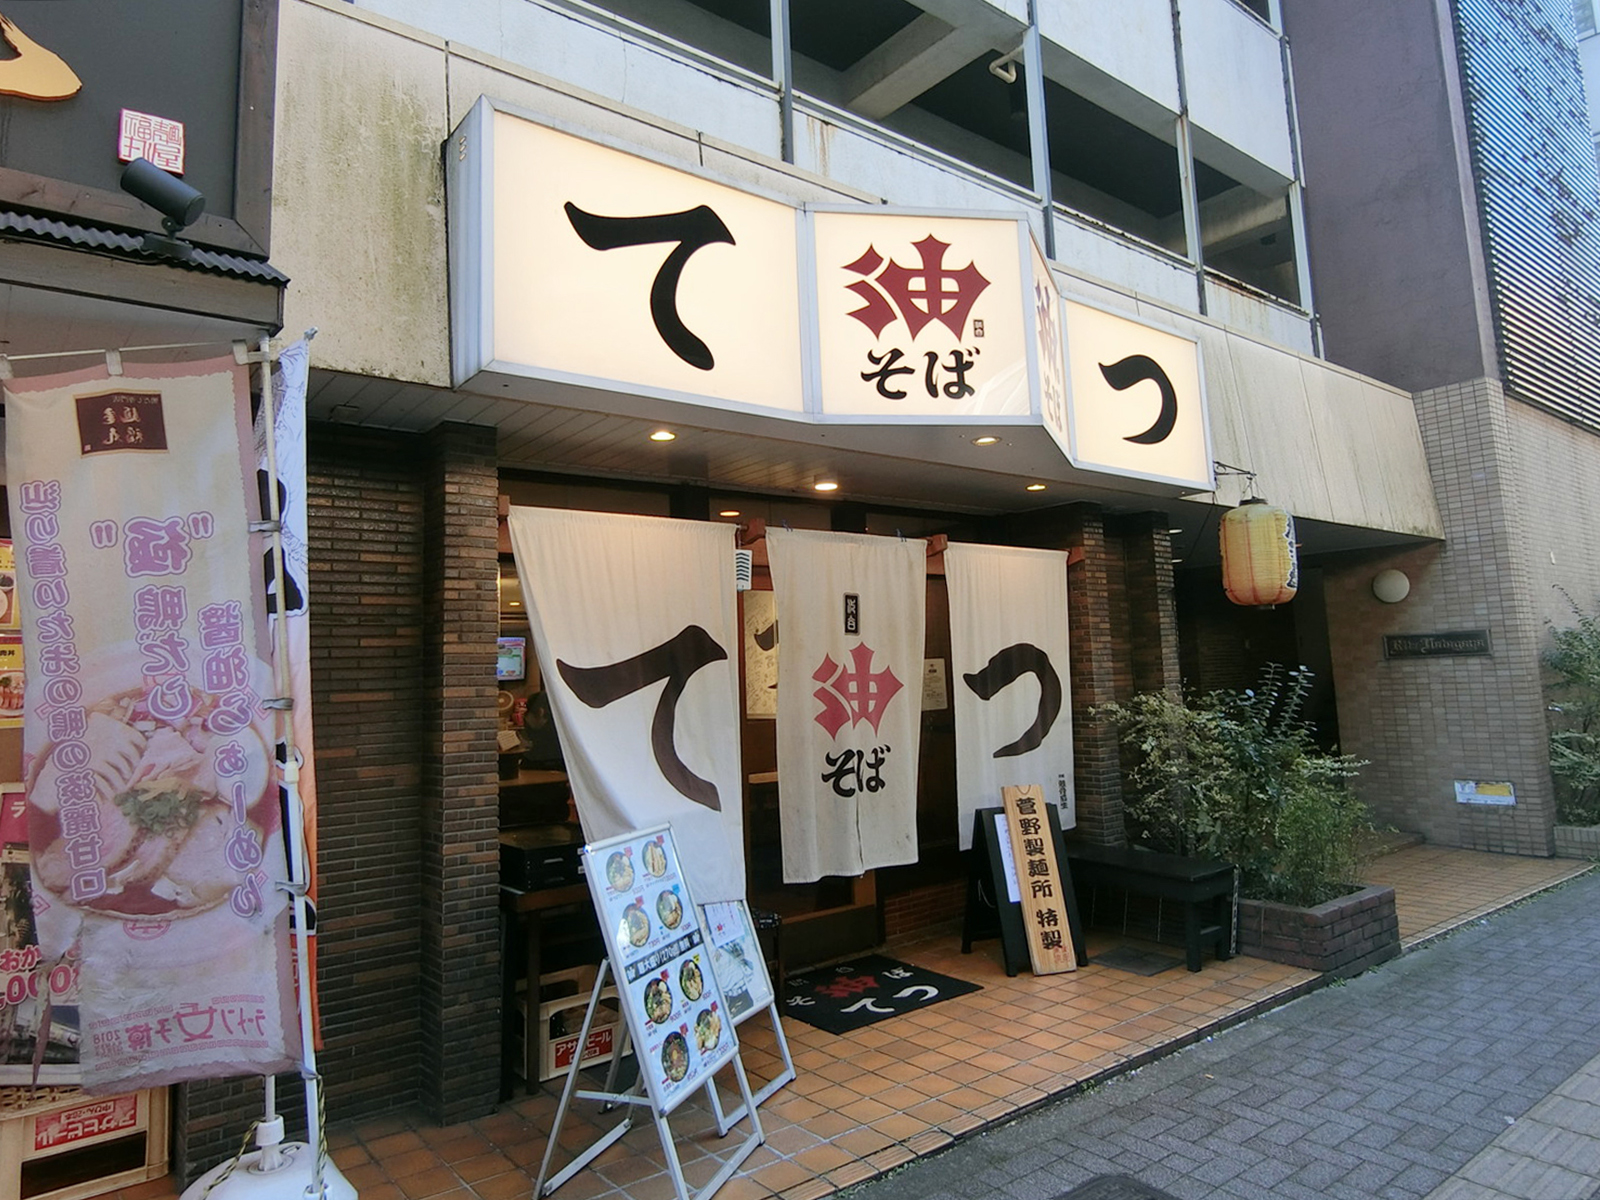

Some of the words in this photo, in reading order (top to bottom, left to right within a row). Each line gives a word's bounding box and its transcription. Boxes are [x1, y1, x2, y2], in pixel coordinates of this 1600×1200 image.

[564, 201, 736, 371] て
[841, 233, 991, 342] 油
[861, 346, 980, 400] そば
[1098, 354, 1178, 445] つ
[556, 625, 728, 812] て
[811, 641, 904, 742] 油
[963, 642, 1062, 758] つ
[821, 744, 891, 799] そば
[1016, 797, 1054, 899] 菅野製麺所
[1036, 907, 1064, 950] 特製
[556, 1032, 612, 1057] アサビール
[37, 1109, 135, 1146] アサヒビール
